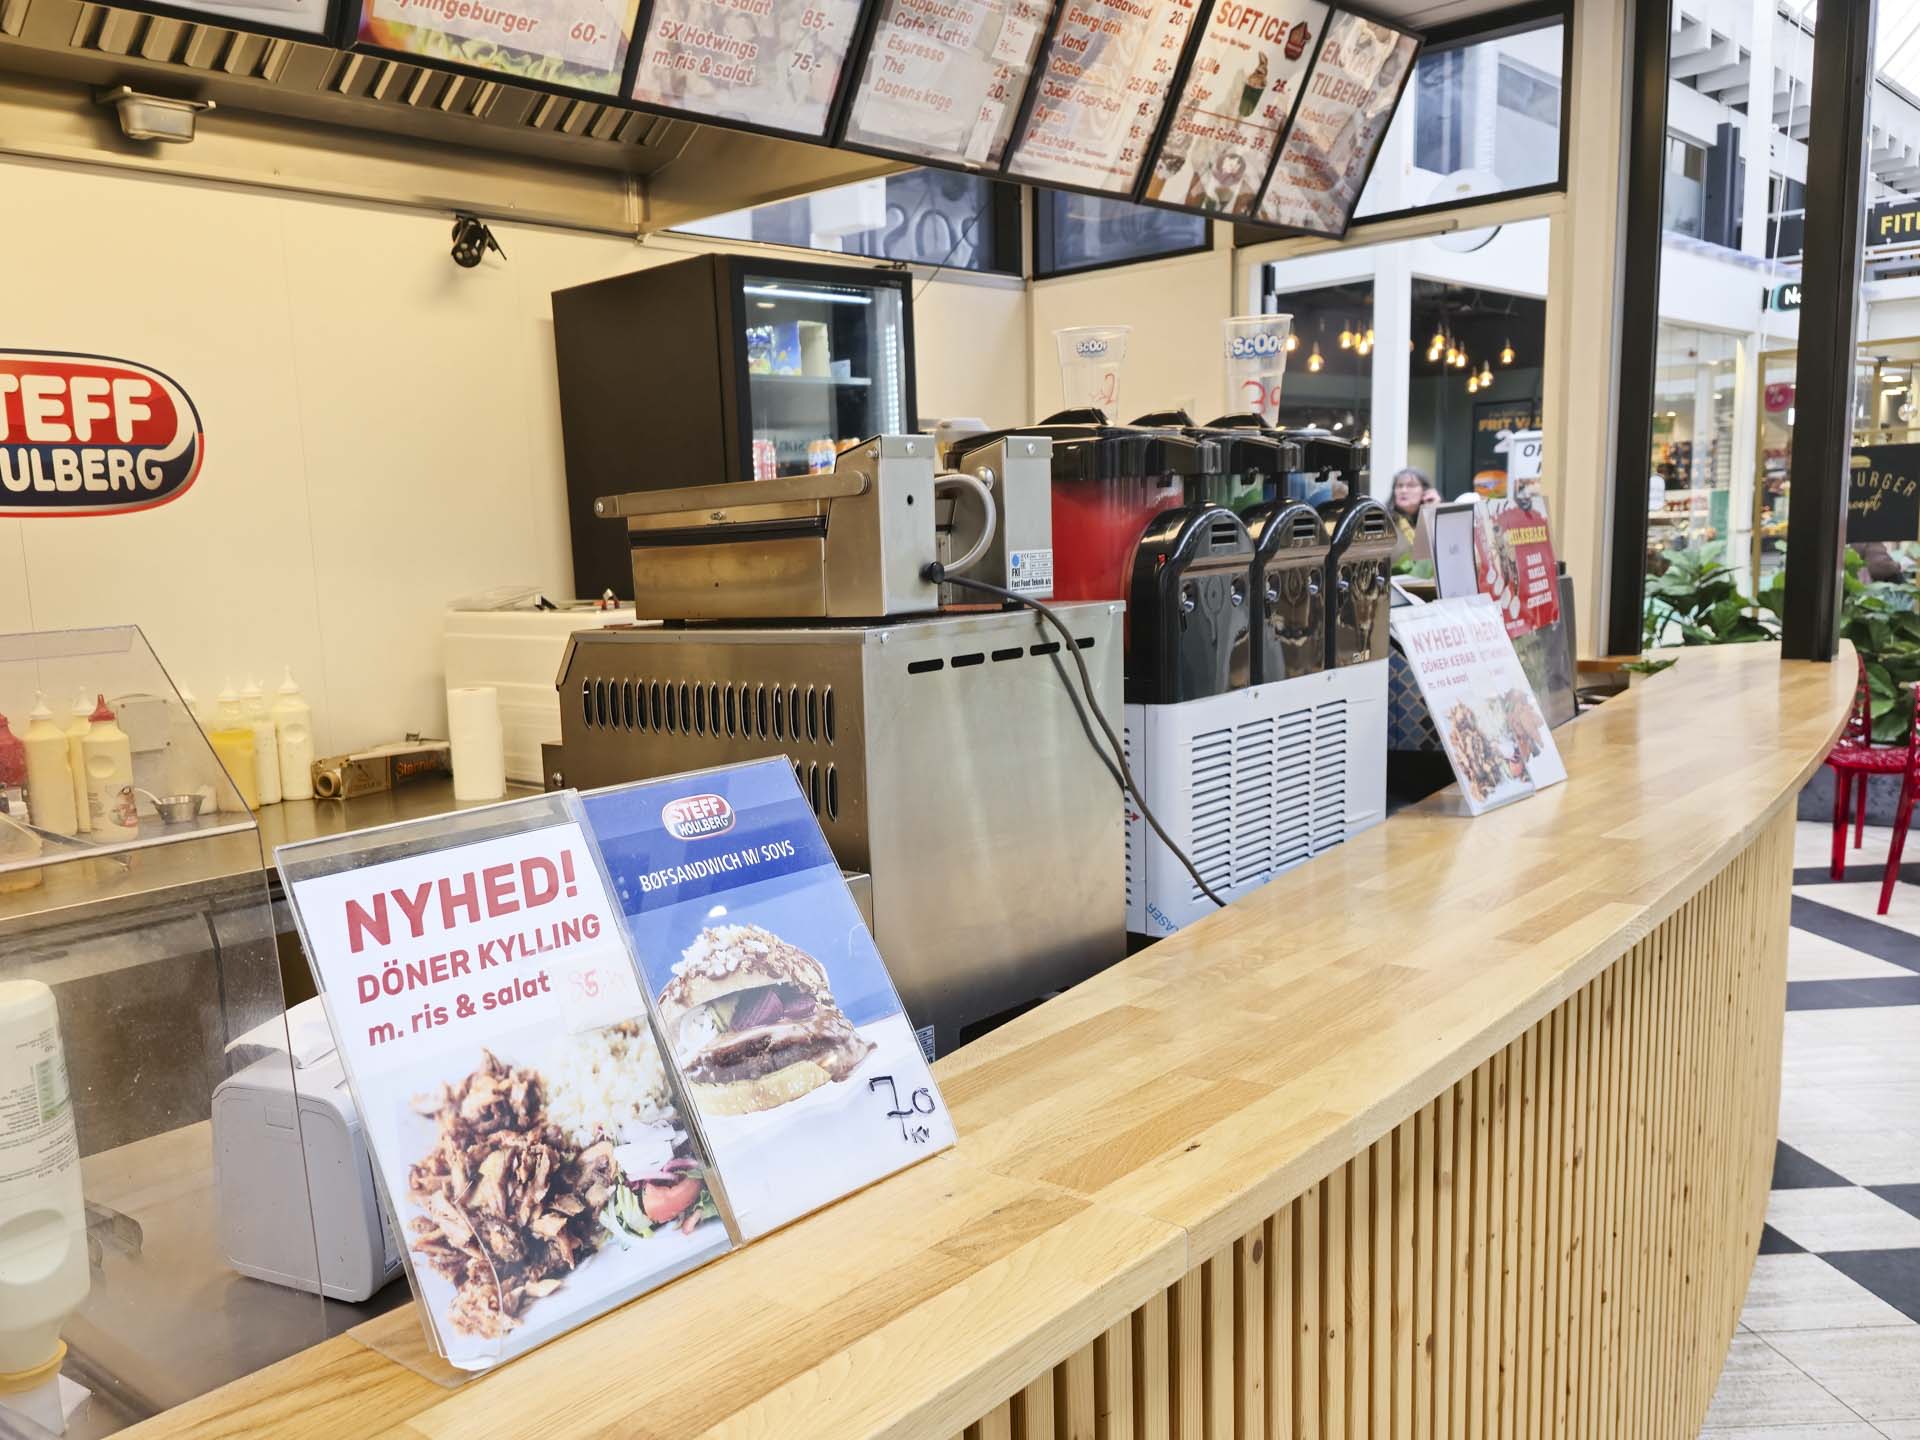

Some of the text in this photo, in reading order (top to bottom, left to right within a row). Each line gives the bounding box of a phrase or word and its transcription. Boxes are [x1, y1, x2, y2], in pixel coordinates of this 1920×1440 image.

[802, 10, 834, 30] 85,-
[901, 0, 974, 24] appuccino
[571, 22, 607, 44] 60,-
[659, 20, 822, 73] 5X Hotwings 75,-
[1060, 32, 1088, 52] Vand
[652, 51, 754, 83] m. ris & salat
[1051, 56, 1081, 77] Cocio
[1849, 470, 1917, 497] URGER
[669, 797, 722, 824] STEFF
[678, 814, 730, 837] HOULBERG
[638, 851, 743, 893] BØFSANDWICH
[761, 839, 796, 862] SOVS
[345, 849, 578, 954] NYHED!
[1145, 902, 1179, 932] ASER
[357, 913, 601, 1005] DÖNER KYLLING
[368, 970, 551, 1047] m. ris & salat
[868, 1075, 936, 1141] 70
